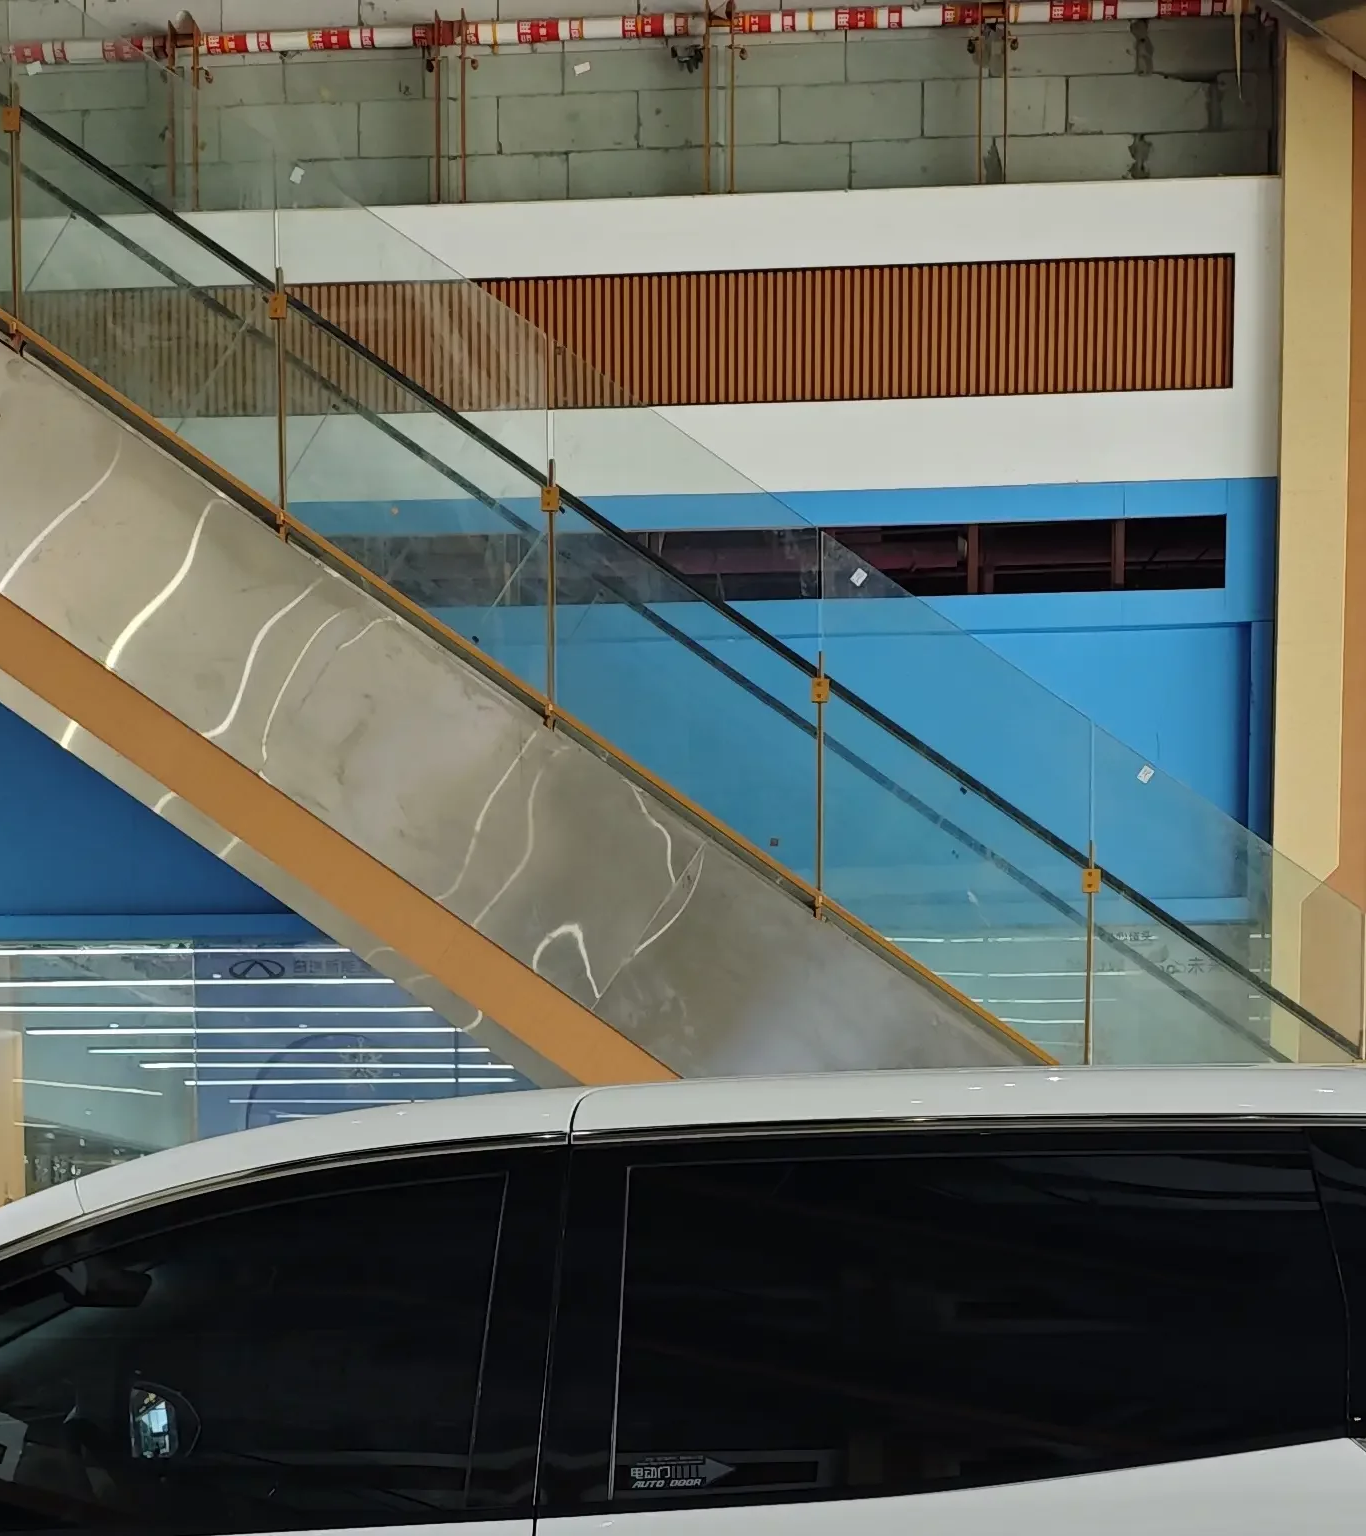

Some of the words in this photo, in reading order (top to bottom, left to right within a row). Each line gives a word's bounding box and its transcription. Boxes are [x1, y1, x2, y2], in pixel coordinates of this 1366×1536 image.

[630, 1465, 671, 1480] 电动门
[632, 1479, 665, 1489] AUTO
[669, 1478, 702, 1487] DOOR
